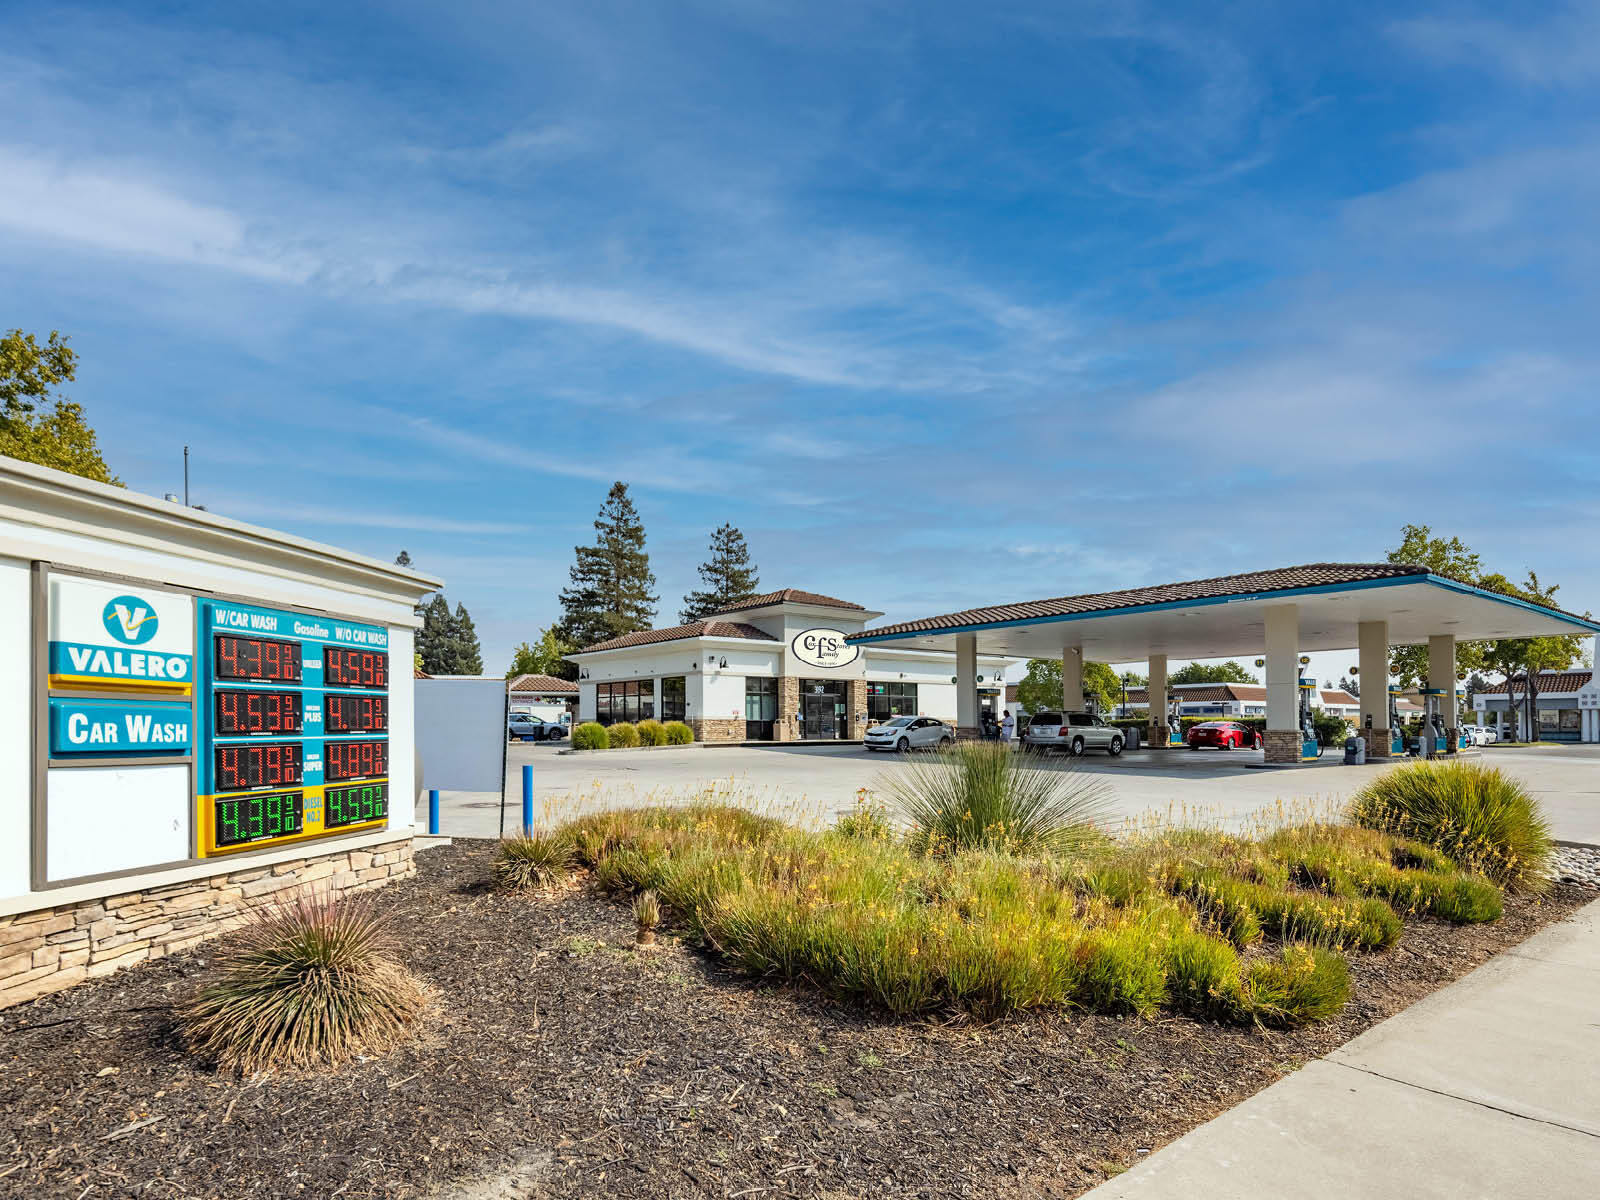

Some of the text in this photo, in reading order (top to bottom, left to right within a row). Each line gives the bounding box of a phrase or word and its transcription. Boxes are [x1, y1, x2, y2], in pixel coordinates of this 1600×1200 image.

[216, 609, 277, 631] W/CAR WASH
[294, 621, 329, 638] Gasoline
[335, 627, 387, 645] W/O CAR WASH
[68, 648, 187, 678] VALERO
[221, 638, 280, 678] 4.39
[329, 650, 374, 684] 4.59
[221, 694, 280, 730] 4.53
[304, 712, 321, 722] PLUS
[222, 747, 281, 786] 4.79
[304, 761, 323, 772] SUPER
[330, 744, 373, 777] 4.89
[222, 797, 282, 839] 4.39
[304, 796, 323, 810] DIESEL
[306, 810, 320, 824] NO.2
[330, 788, 373, 823] 4.59
